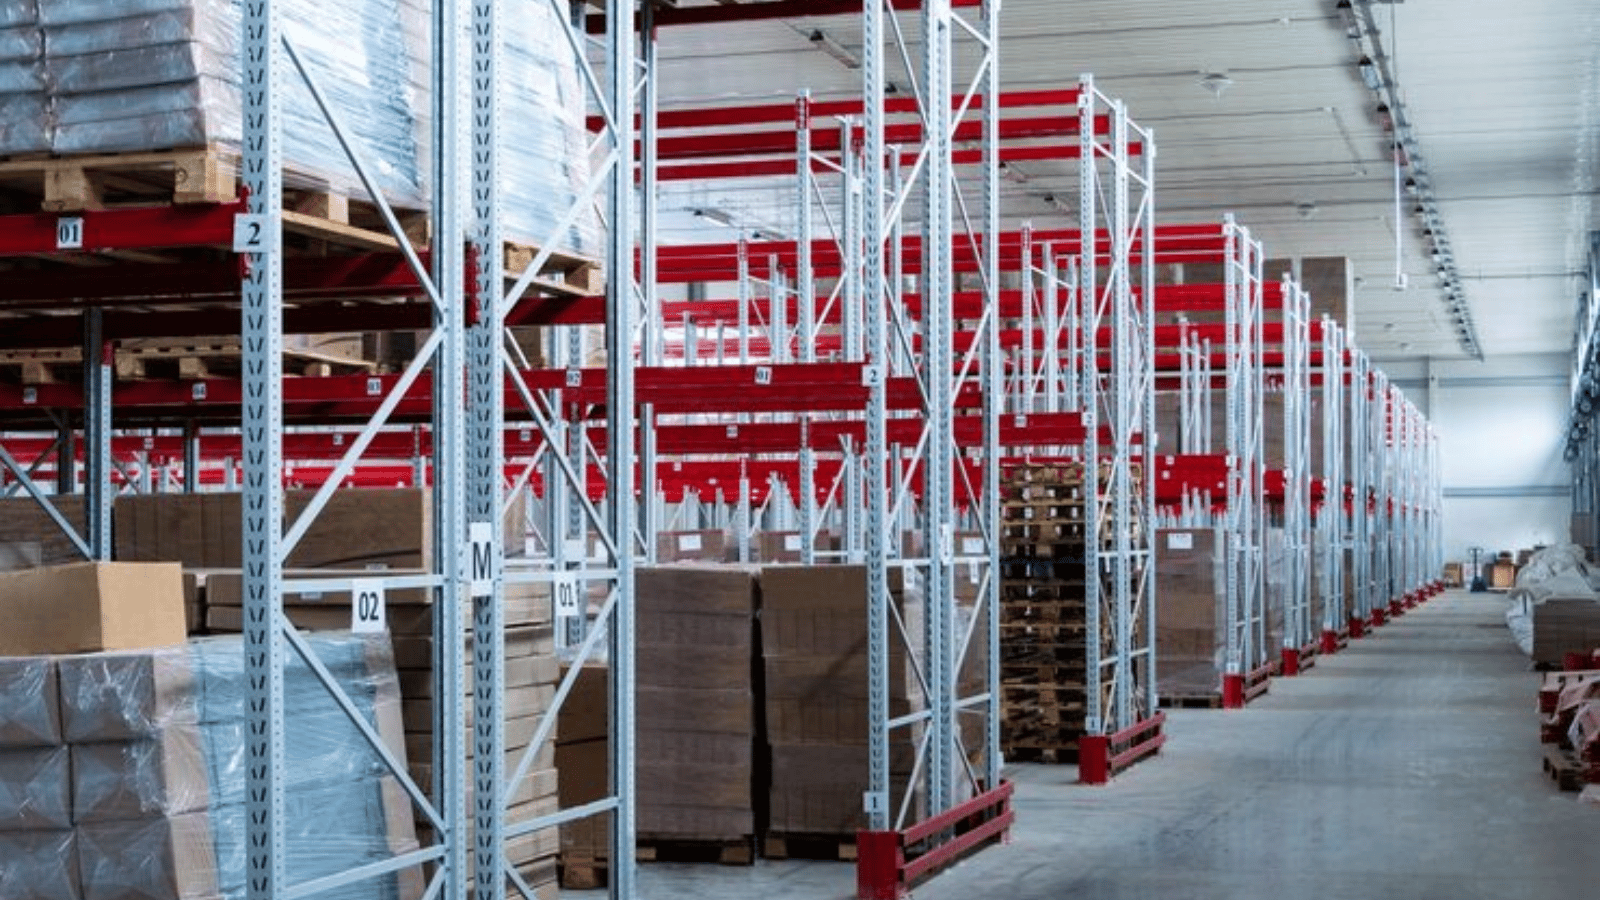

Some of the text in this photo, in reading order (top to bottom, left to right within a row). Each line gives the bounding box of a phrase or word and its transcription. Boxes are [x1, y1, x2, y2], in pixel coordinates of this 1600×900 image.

[60, 223, 78, 244] 01
[247, 222, 261, 246] 2
[869, 368, 878, 383] 2
[472, 541, 492, 580] M
[358, 591, 379, 622] 02
[559, 581, 574, 607] 01
